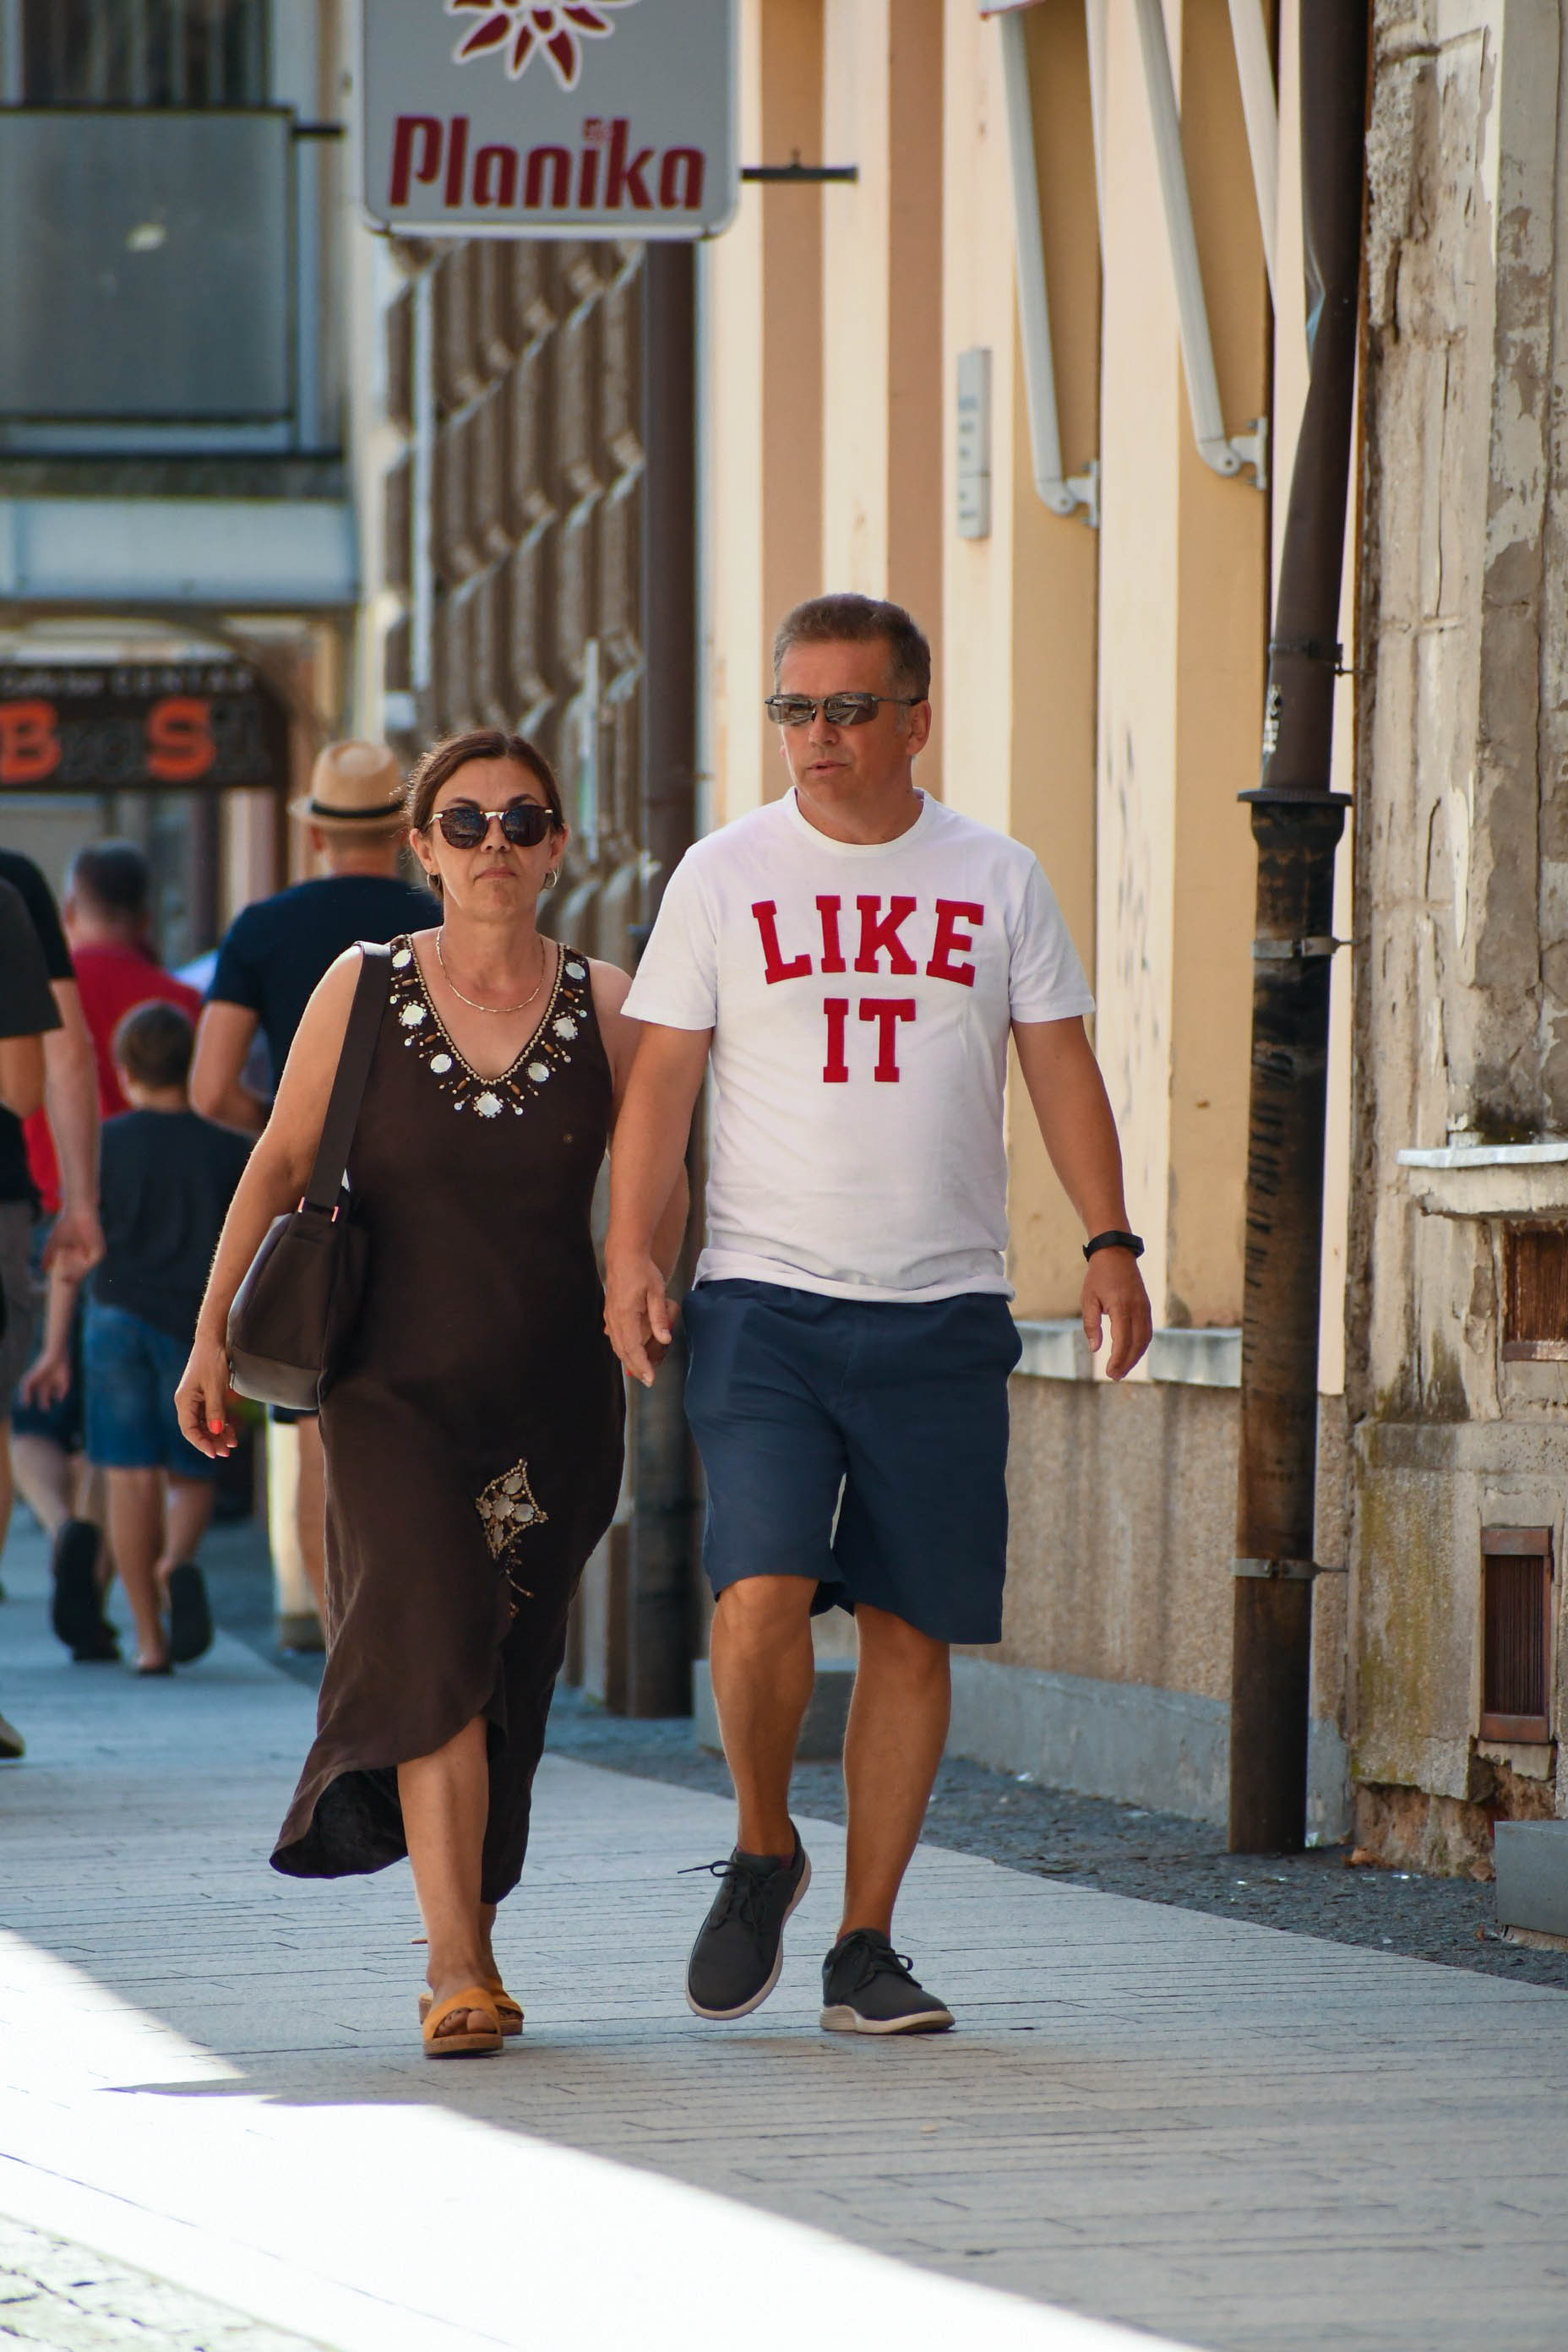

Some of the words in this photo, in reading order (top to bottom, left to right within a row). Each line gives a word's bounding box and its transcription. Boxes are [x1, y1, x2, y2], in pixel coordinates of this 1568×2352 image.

[389, 115, 706, 210] Planika
[751, 895, 984, 988] LIKE
[823, 997, 917, 1083] IT
